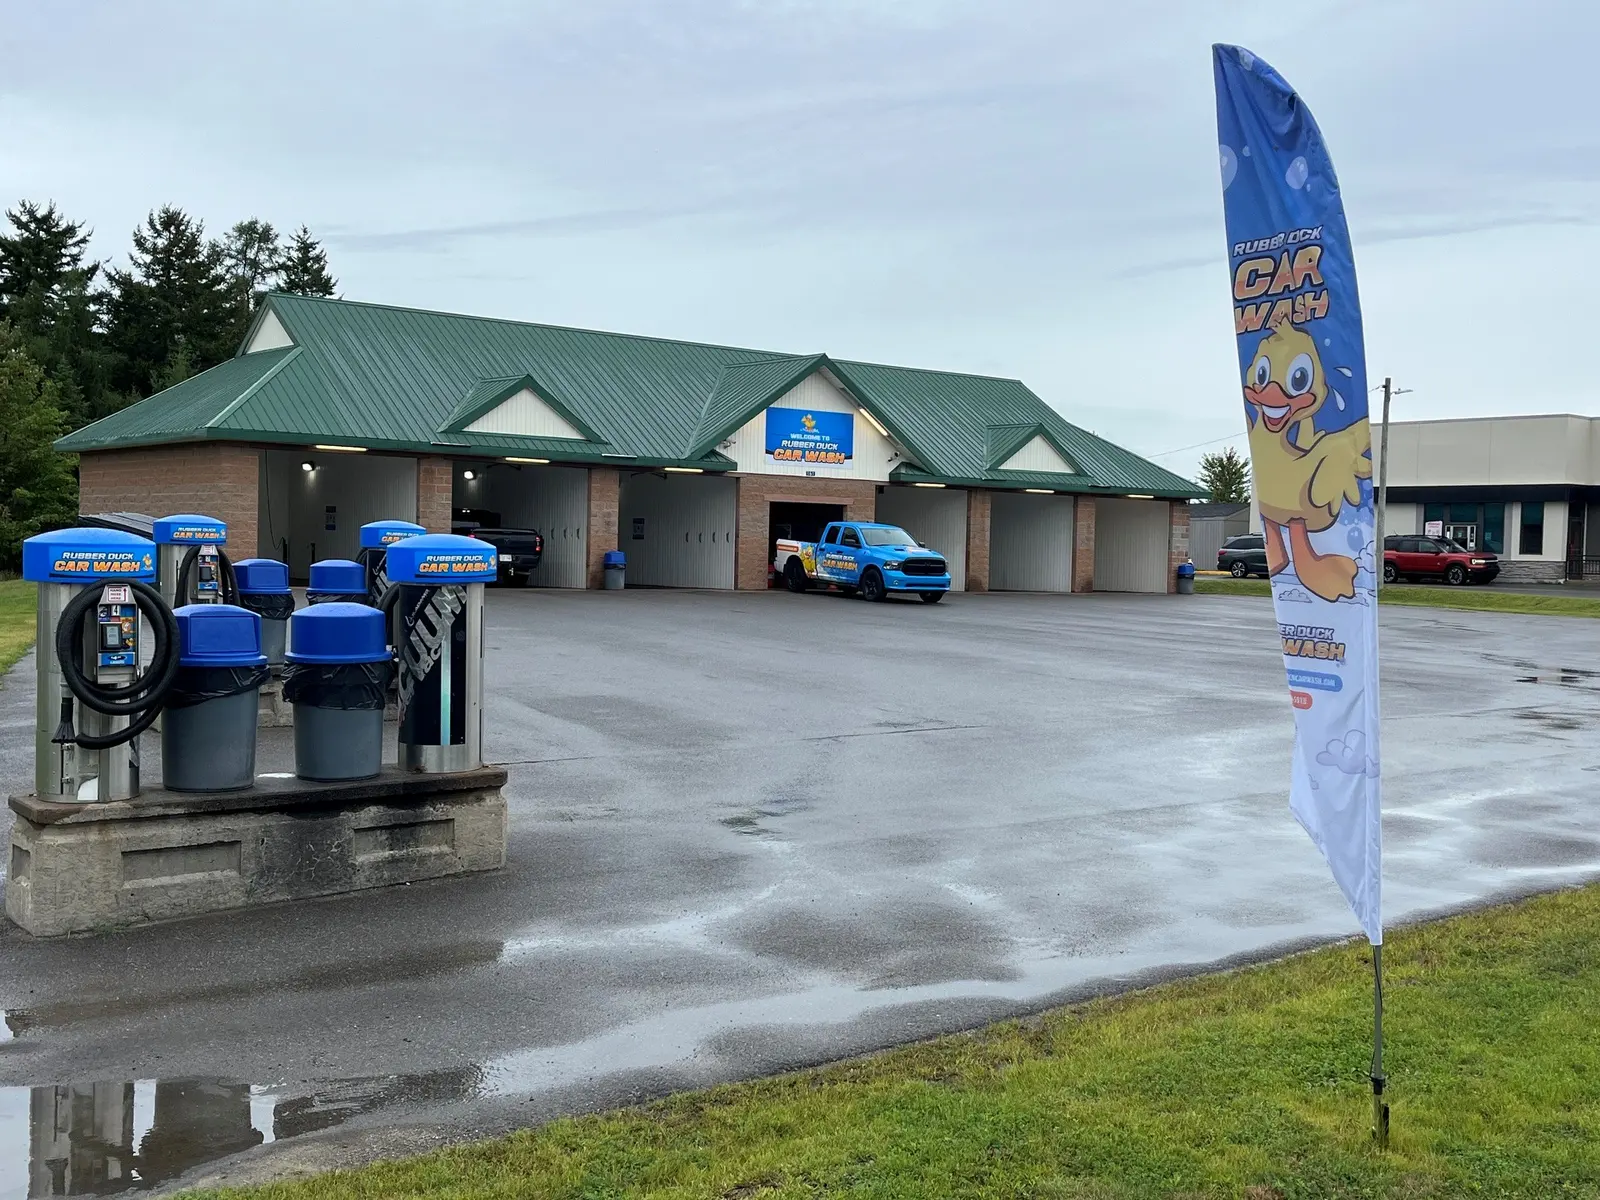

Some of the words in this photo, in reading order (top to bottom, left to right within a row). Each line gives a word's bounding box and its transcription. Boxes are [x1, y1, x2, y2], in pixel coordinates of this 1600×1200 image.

[1233, 245, 1324, 300] CAR
[1234, 289, 1329, 334] WASH
[790, 433, 820, 441] WELCOME
[781, 440, 815, 449] RUBBER
[816, 442, 838, 450] DUCK
[773, 448, 802, 461] CAR
[805, 450, 845, 464] WASH
[62, 552, 106, 560] RUBBER
[54, 560, 90, 572] CAR
[93, 561, 141, 572] WASH
[419, 562, 449, 572] CAR
[452, 562, 488, 572] WASH
[1296, 625, 1334, 640] DUCK
[1281, 637, 1346, 661] WASH
